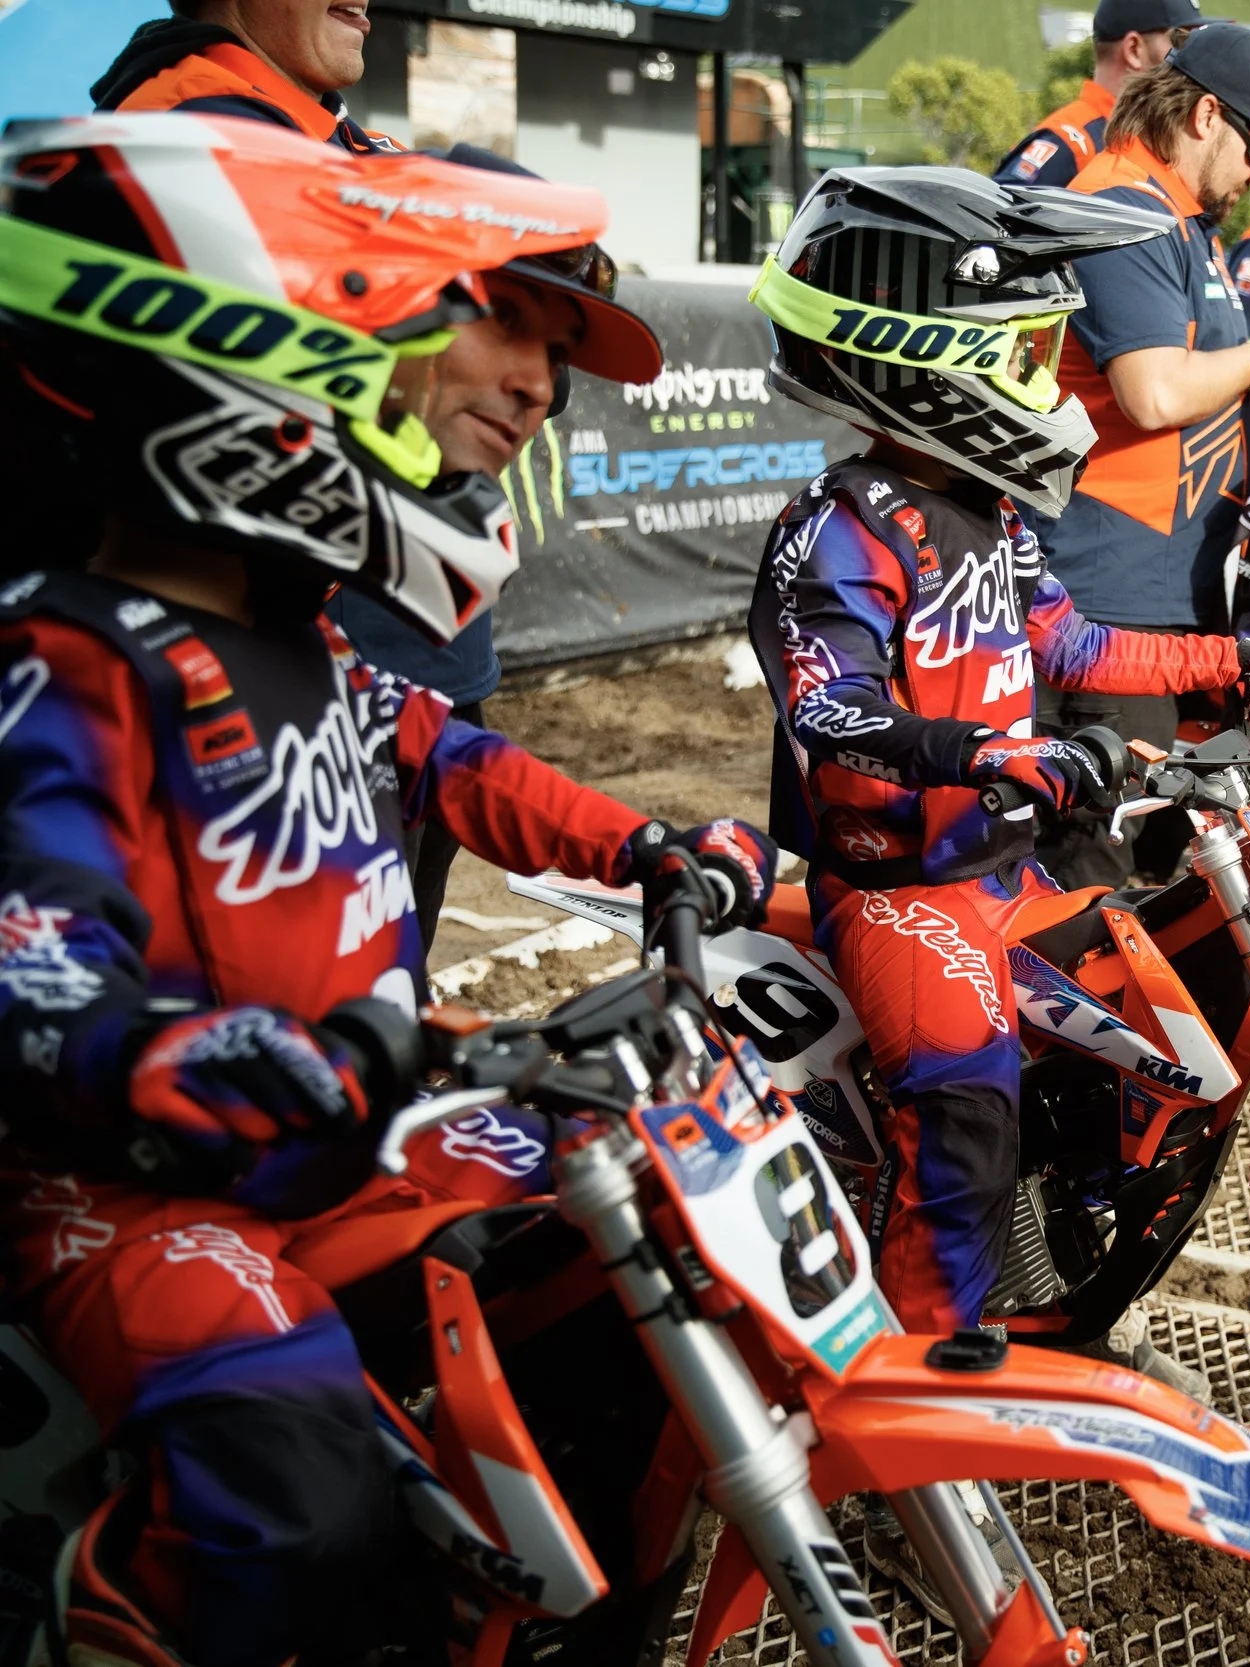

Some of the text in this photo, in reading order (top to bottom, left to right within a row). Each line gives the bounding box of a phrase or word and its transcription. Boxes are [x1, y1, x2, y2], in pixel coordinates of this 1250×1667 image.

[53, 259, 389, 399] 100%
[827, 308, 1009, 369] 100%
[651, 411, 755, 434] ENERGY
[893, 378, 1081, 491] BELL
[568, 439, 828, 497] SUPERCROSS
[867, 481, 893, 506] KTM
[906, 539, 1019, 669] Troy
[918, 581, 944, 594] PERCROSS
[925, 570, 942, 584] TEAM
[982, 641, 1034, 704] KTM
[836, 750, 902, 784] KTM
[198, 700, 378, 905] Troy
[336, 848, 416, 957] KTM
[559, 894, 628, 919] DUNLOP
[893, 899, 1010, 1034] Designs
[1135, 1055, 1204, 1096] KTM
